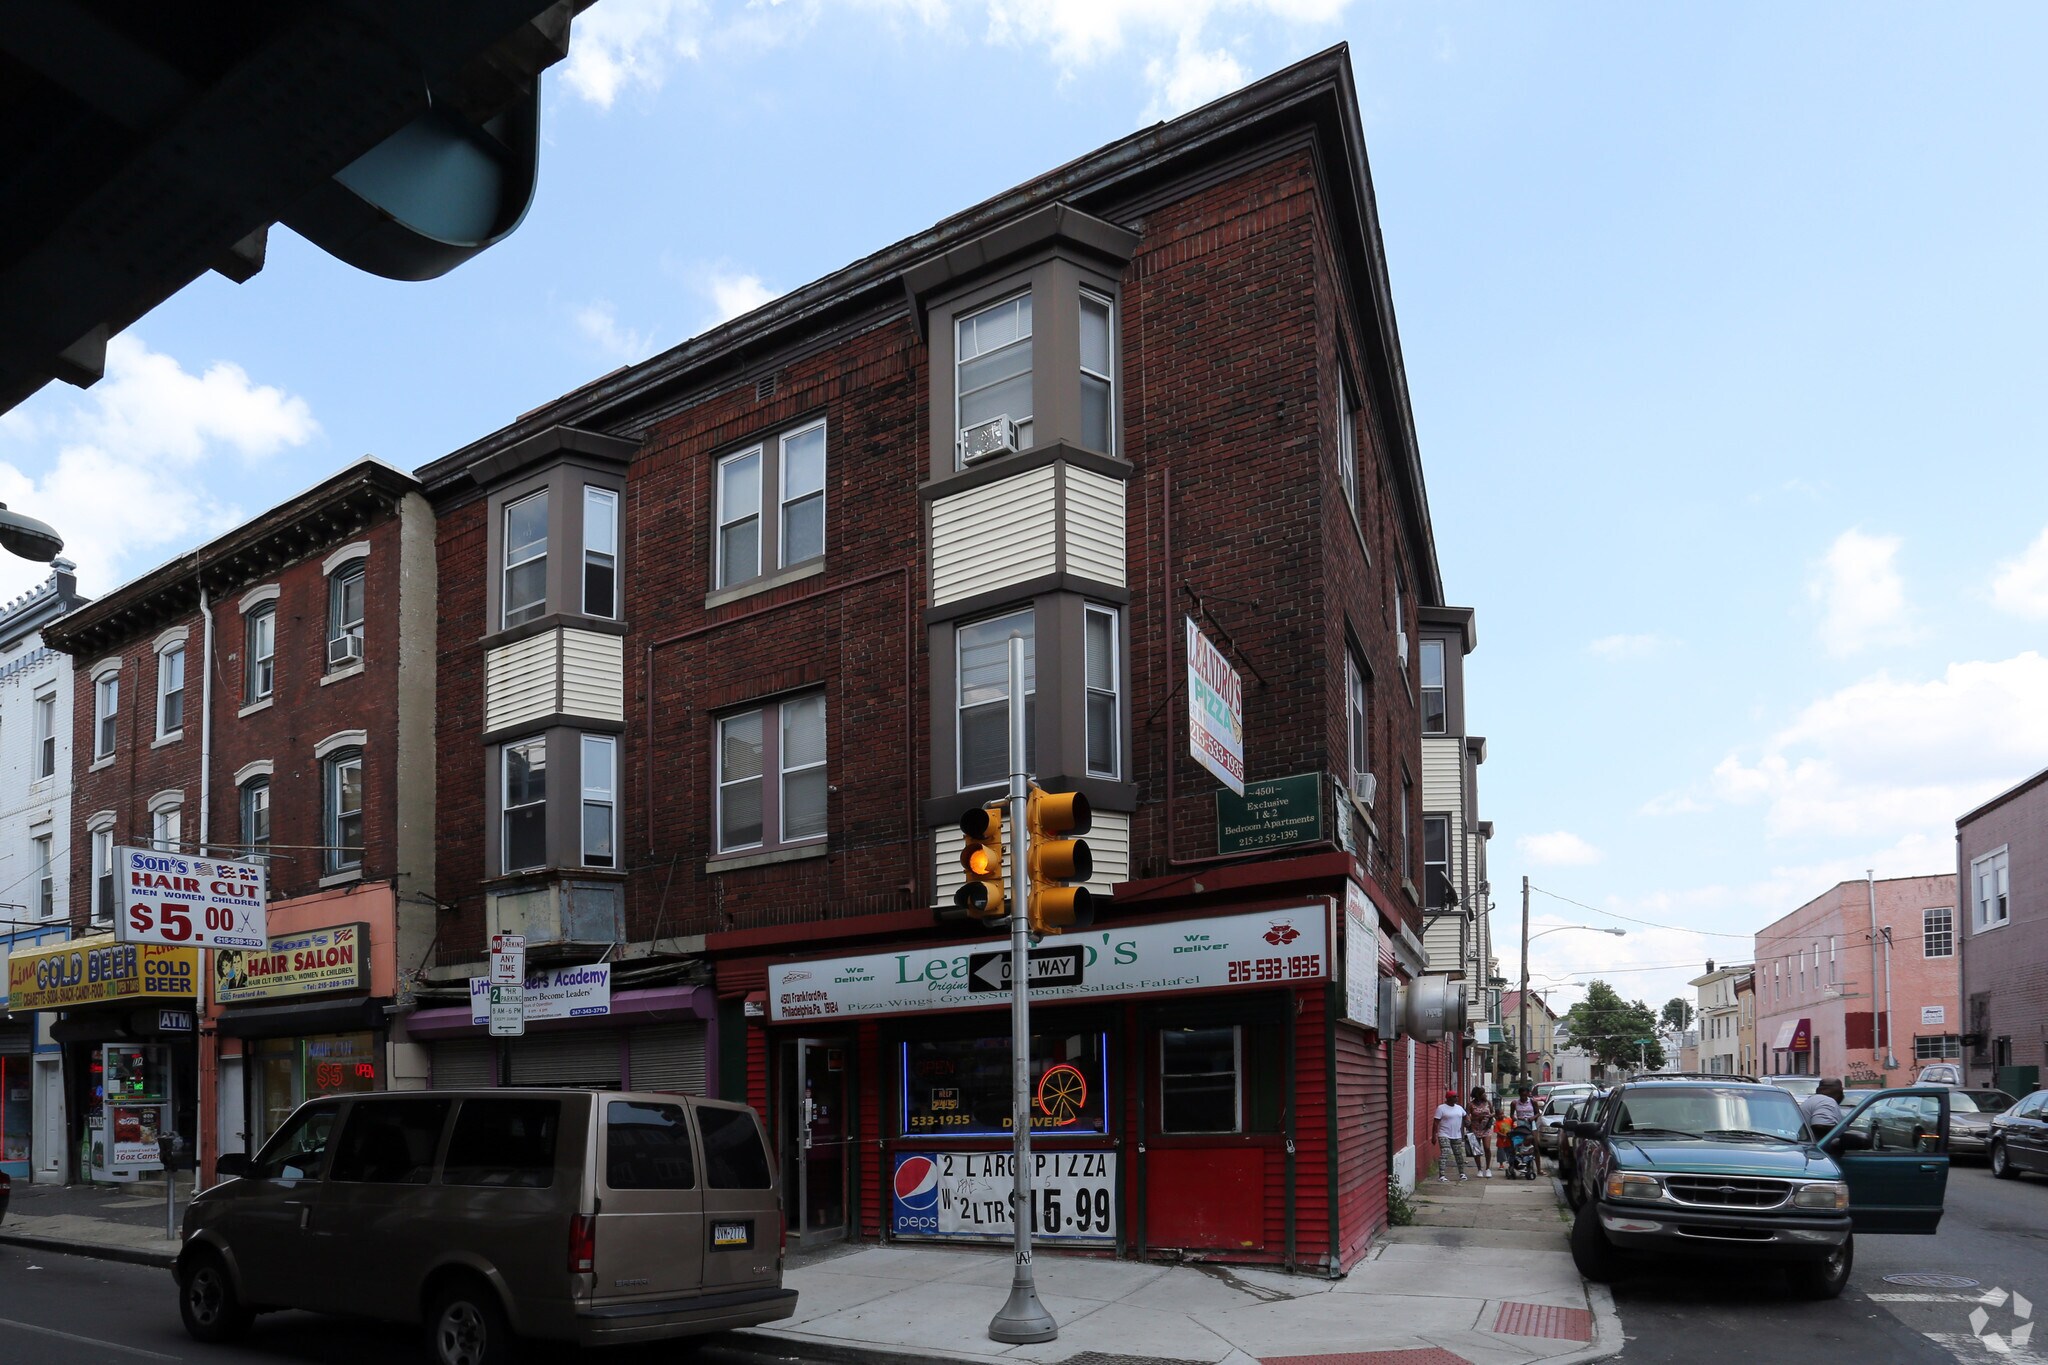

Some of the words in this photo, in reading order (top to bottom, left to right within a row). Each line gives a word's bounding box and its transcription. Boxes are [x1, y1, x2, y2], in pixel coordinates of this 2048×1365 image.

[1188, 625, 1241, 716] LEANDRO'S
[1195, 677, 1232, 734] PIZZA
[1190, 720, 1244, 781] 215-533-1935
[1247, 798, 1289, 811] Exclusive
[1262, 811, 1270, 819] &
[1272, 809, 1278, 817] 2
[1225, 824, 1261, 835] Bedroom
[1264, 815, 1315, 829] Apartments
[131, 853, 189, 875] Son's
[131, 872, 200, 893] HAIR
[210, 881, 259, 899] CUT
[132, 888, 158, 896] MEN
[164, 891, 205, 901] WOMEN
[212, 896, 260, 907] CHILDREN
[216, 937, 261, 946] 215-289-1576
[270, 934, 328, 953] Son's
[492, 940, 501, 950] NO
[502, 940, 524, 948] PARKING
[1184, 933, 1210, 942] We
[1173, 941, 1229, 955] Deliver
[248, 954, 289, 977] HAIR
[294, 944, 354, 972] SALON
[500, 955, 515, 963] ANY
[1038, 958, 1071, 976] WAY
[10, 961, 36, 992] Lina
[37, 952, 82, 990] COLD
[88, 944, 137, 983] BEER
[144, 960, 191, 976] COLD
[261, 977, 271, 985] CUT
[272, 975, 283, 983] FOR
[298, 972, 318, 980] WOMEN
[326, 967, 353, 977] CHILDREN
[500, 964, 516, 973] TIME
[1228, 954, 1320, 983] 215-533-1935
[145, 977, 192, 993] BEER
[471, 978, 491, 995] Litt
[524, 974, 549, 990] ders
[554, 968, 608, 987] Academy
[834, 975, 875, 984] Deliver
[1141, 975, 1200, 989] Falafel
[232, 989, 256, 999] Frankford
[492, 989, 499, 1002] 2
[539, 992, 564, 1001] Become
[161, 1012, 190, 1028] ATM
[317, 1061, 343, 1089] $5
[911, 1115, 970, 1126] 533-1935
[1002, 1117, 1062, 1128] DIVER
[116, 1153, 135, 1161] 16oz
[943, 1155, 953, 1177] 2
[967, 1154, 1015, 1177] LARG
[1036, 1154, 1106, 1177] PIZZA
[899, 1216, 937, 1231] peps
